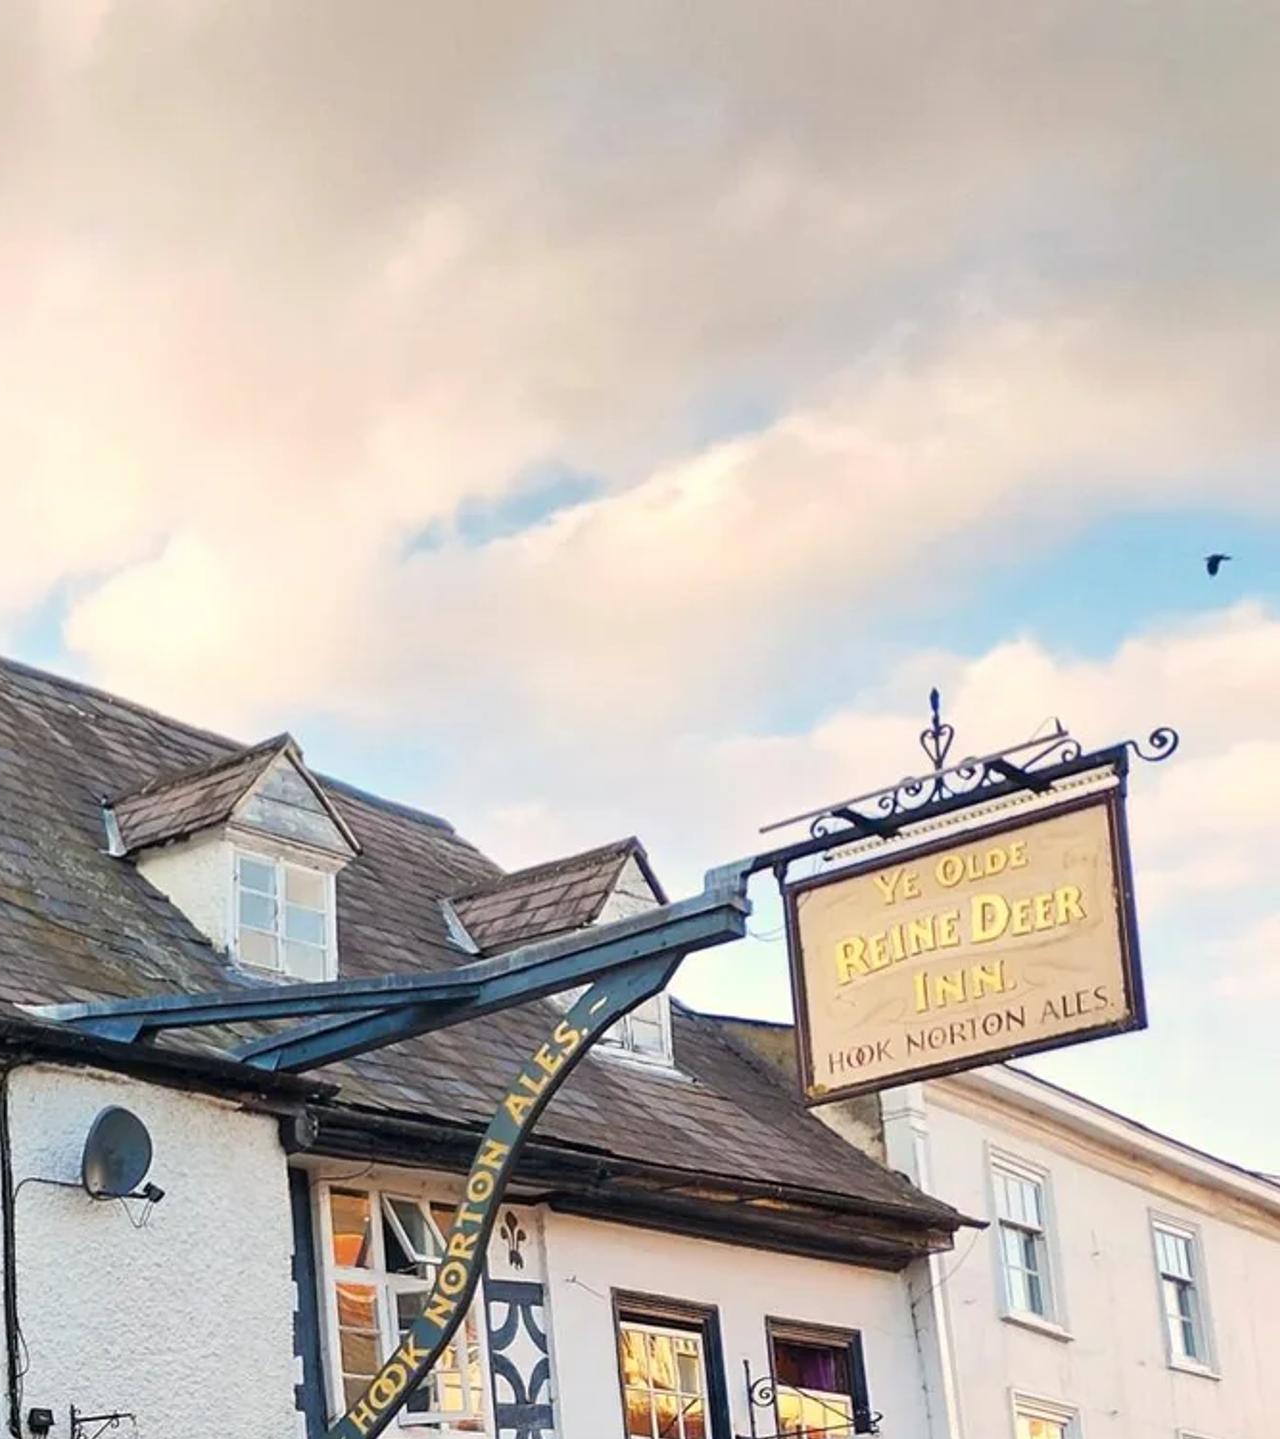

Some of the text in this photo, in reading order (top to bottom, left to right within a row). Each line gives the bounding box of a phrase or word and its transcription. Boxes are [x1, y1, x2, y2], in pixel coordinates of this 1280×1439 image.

[835, 885, 1088, 986] REINE DEER
[828, 1041, 894, 1074] HOOK
[907, 1006, 1027, 1052] NORTON
[348, 1333, 431, 1437] HOOK
[424, 1138, 510, 1329] NORTON
